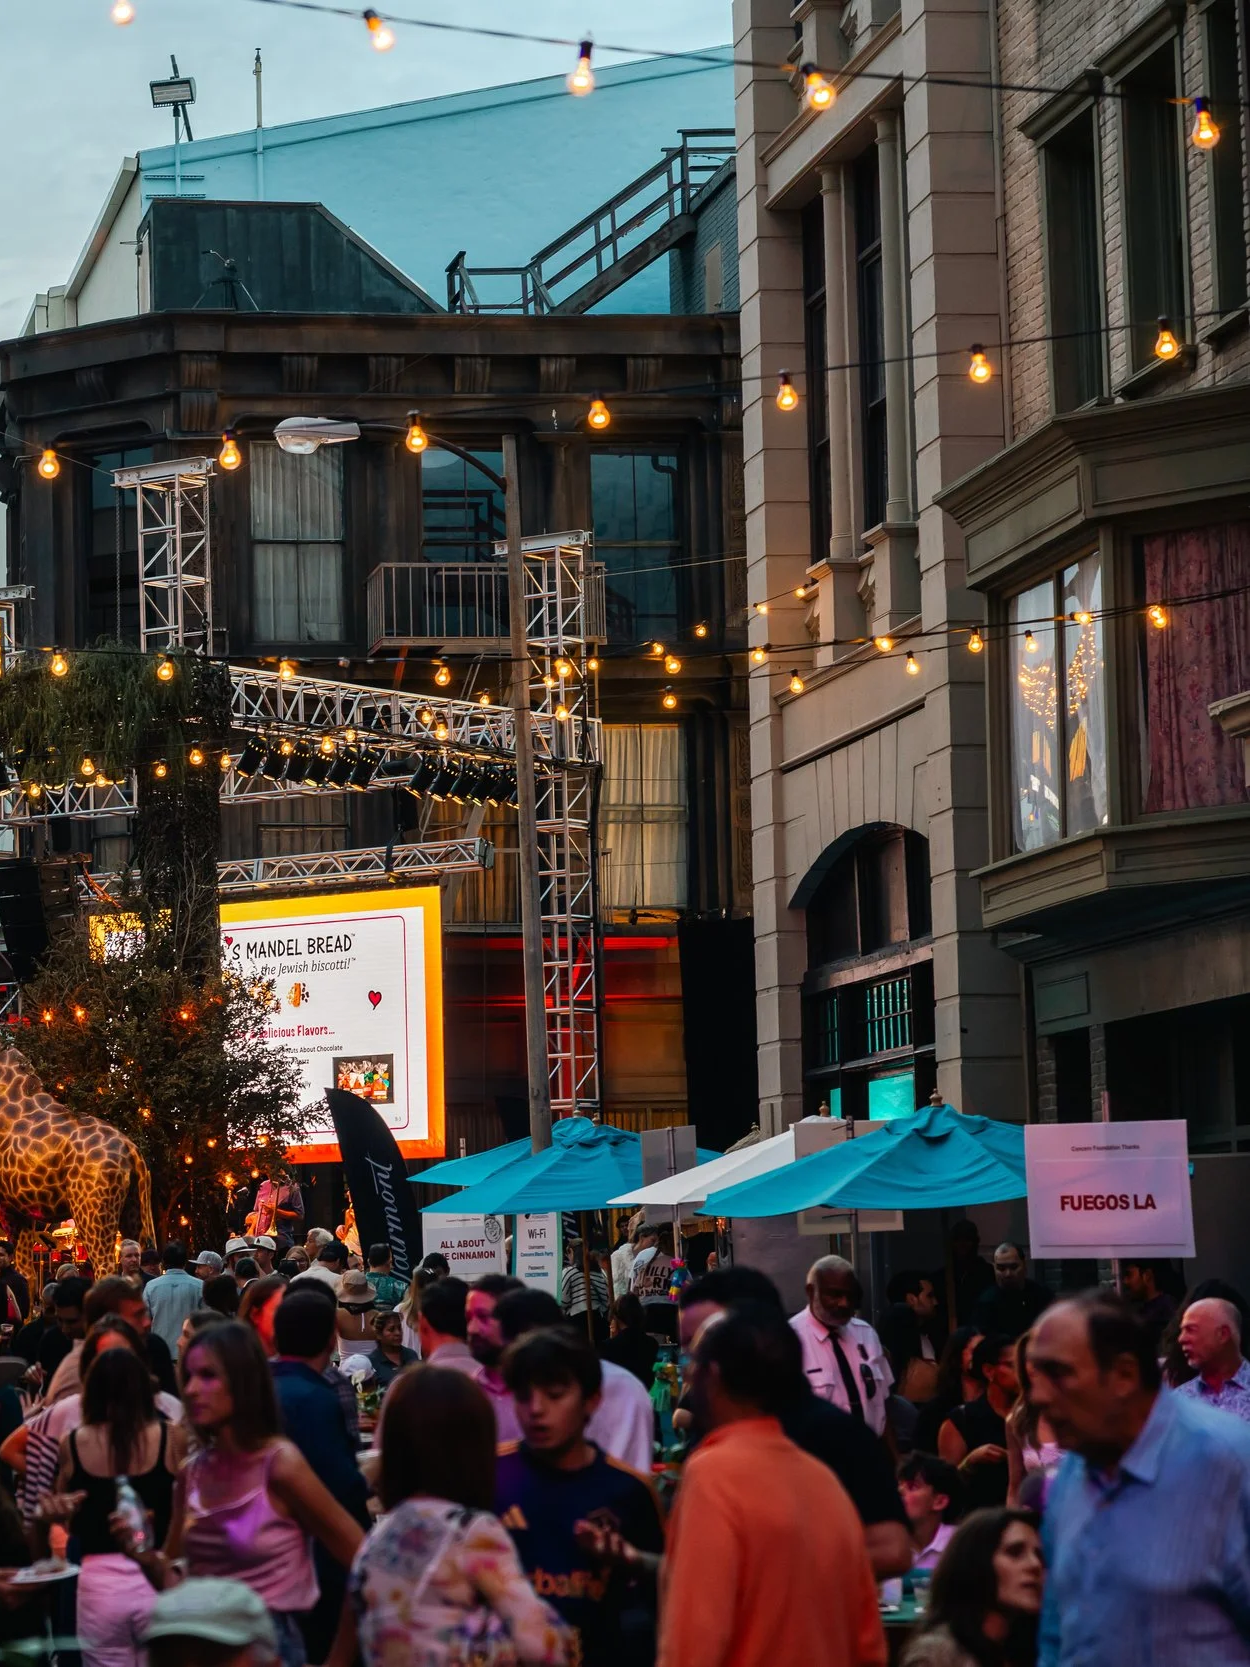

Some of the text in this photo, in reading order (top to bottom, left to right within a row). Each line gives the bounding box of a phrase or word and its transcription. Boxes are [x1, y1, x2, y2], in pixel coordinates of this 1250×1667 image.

[246, 938, 302, 960] MANDEL
[277, 960, 309, 978] Jewish
[316, 1044, 343, 1053] Chocolate
[1060, 1193, 1157, 1211] FUEGOS LA
[363, 1152, 412, 1283] airmont
[527, 1228, 547, 1240] Wi-Fi
[440, 1239, 485, 1249] ALL ABOUT
[451, 1250, 496, 1261] CINNAMON
